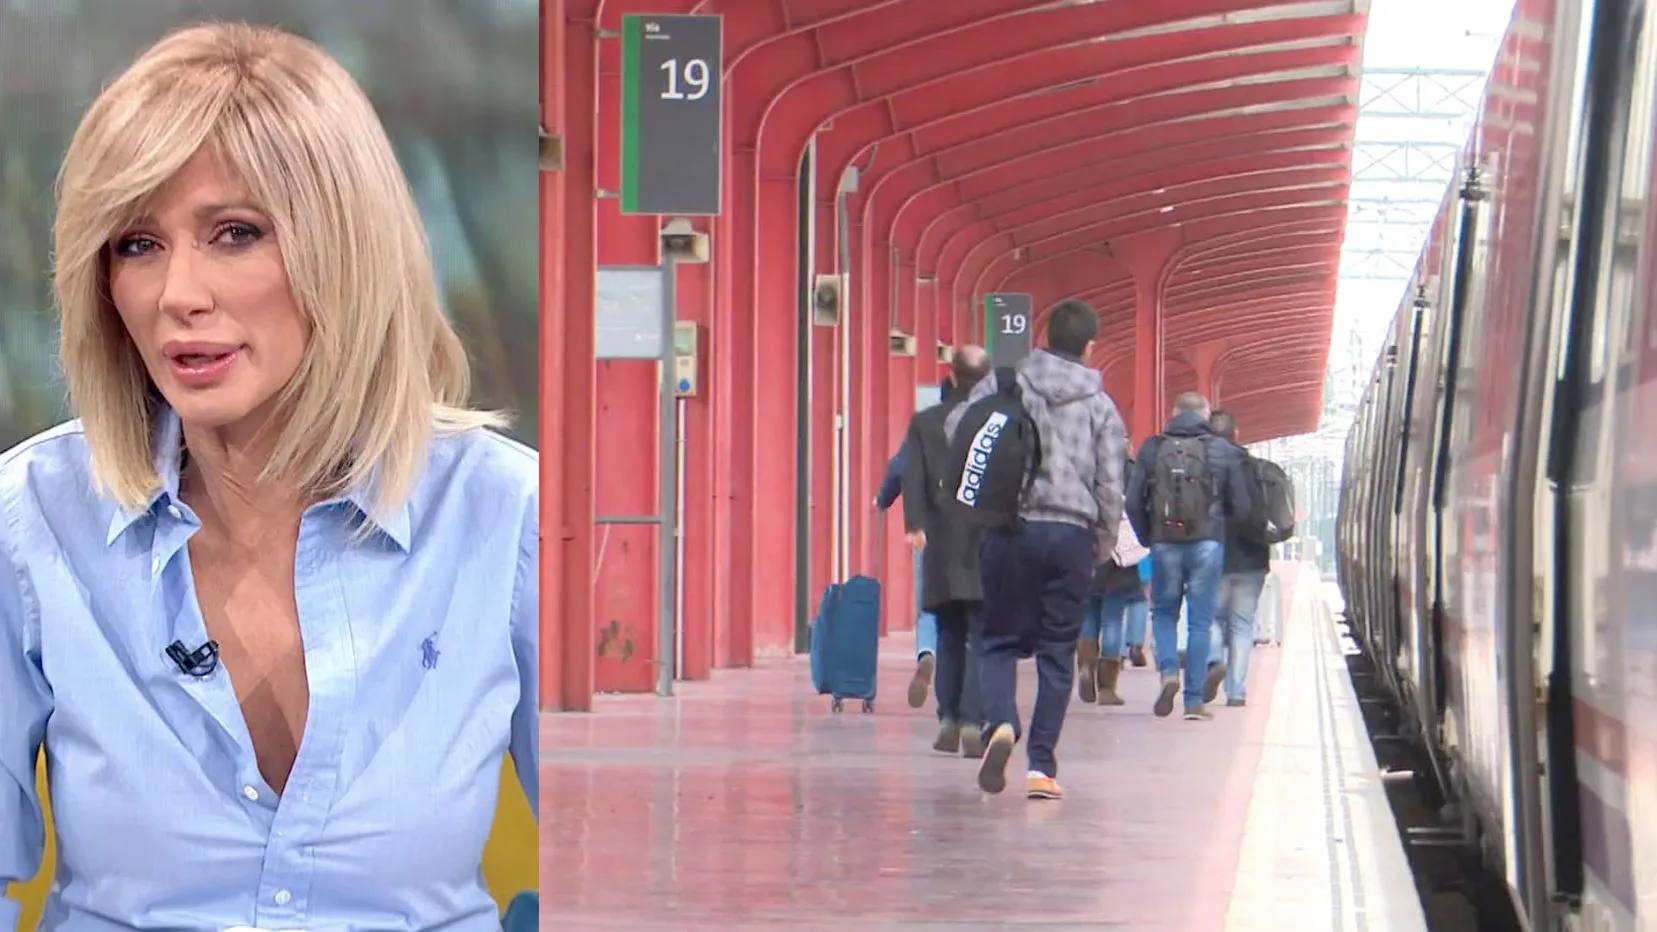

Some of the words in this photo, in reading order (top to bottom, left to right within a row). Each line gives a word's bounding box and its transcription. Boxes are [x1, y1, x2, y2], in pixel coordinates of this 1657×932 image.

[660, 58, 709, 100] 19
[1001, 313, 1026, 334] 19
[963, 422, 1002, 502] adidas
